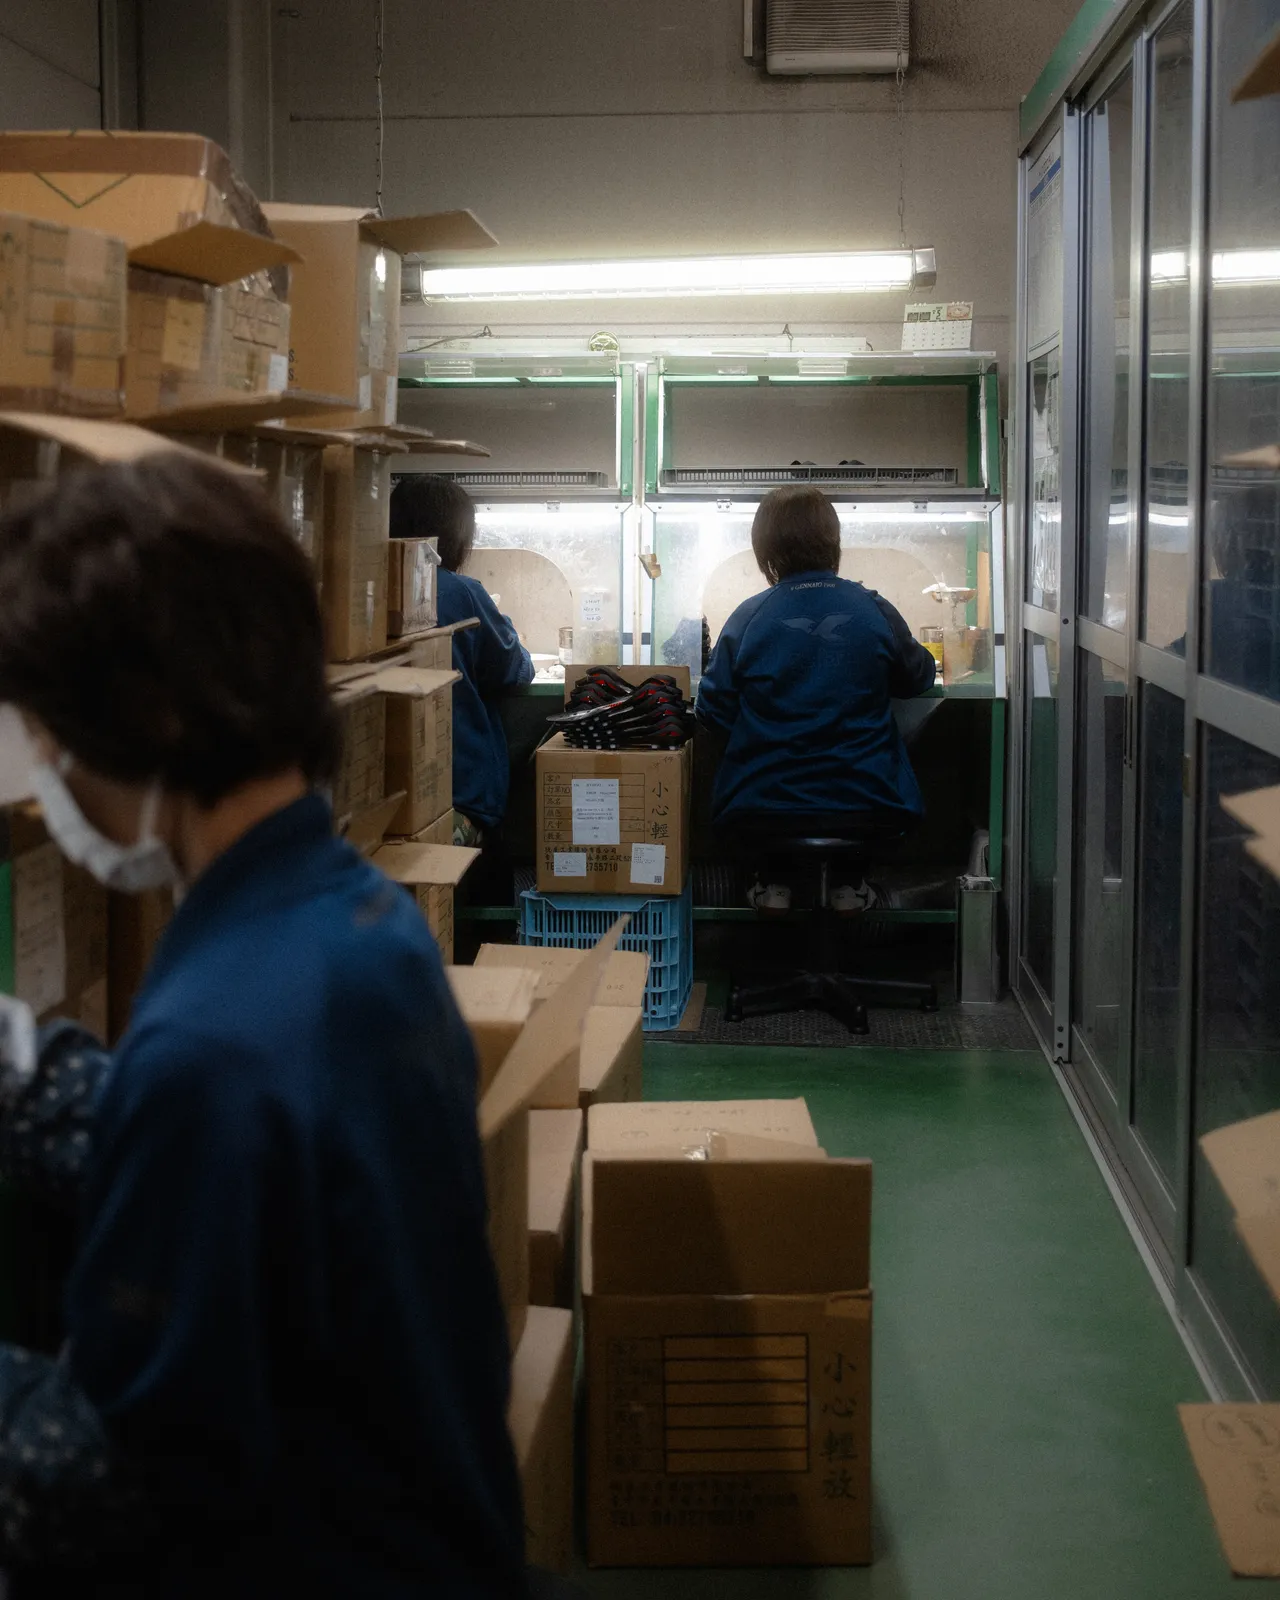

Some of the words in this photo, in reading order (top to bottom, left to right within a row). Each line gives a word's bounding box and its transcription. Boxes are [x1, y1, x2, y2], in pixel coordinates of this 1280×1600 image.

[650, 782, 670, 845] 小心輕
[820, 1352, 859, 1500] 小心輕放
